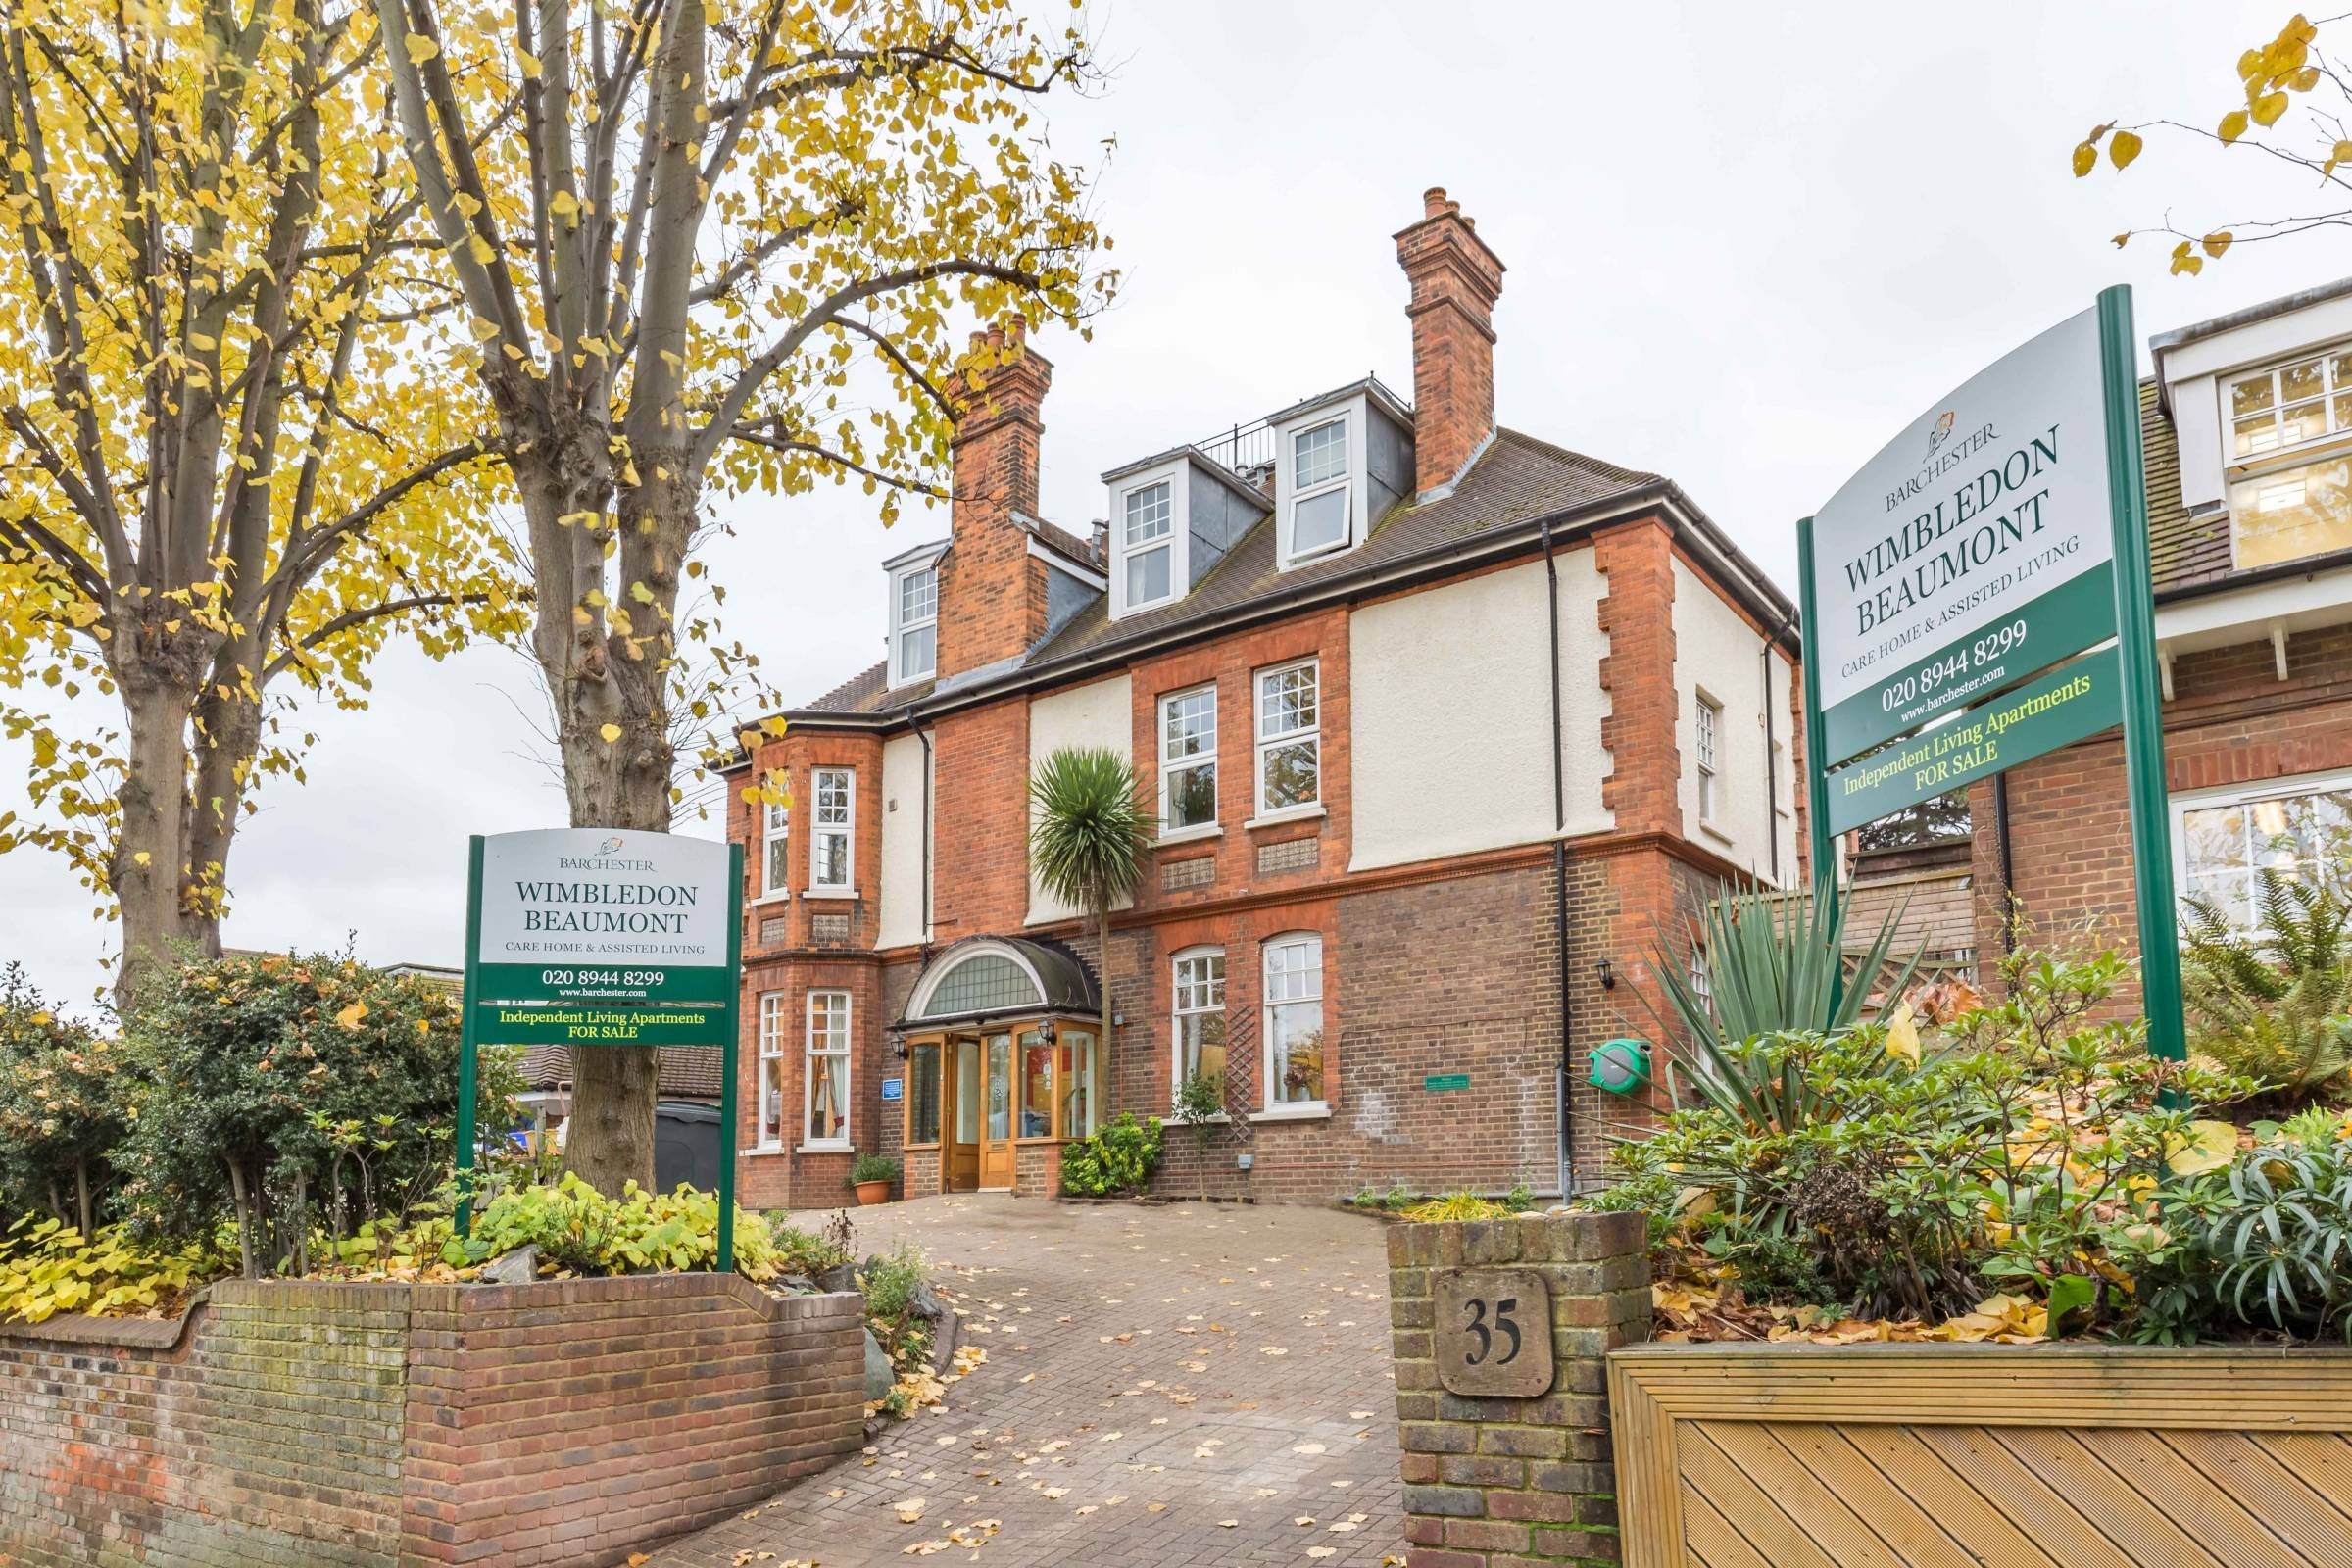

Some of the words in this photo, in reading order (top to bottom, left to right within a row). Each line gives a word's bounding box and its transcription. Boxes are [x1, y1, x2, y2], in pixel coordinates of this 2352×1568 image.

[1885, 423, 2001, 513] BARCHESTER
[1844, 424, 2060, 592] WIMBLEDON
[1856, 488, 2048, 636] BEAUMONT
[1841, 649, 1876, 679] CARE
[1879, 624, 1922, 658] HOME
[1924, 619, 1935, 632] &
[1937, 574, 2012, 622] ASSISTED
[2017, 535, 2080, 580] LIVING
[1882, 676, 1916, 713] 020
[1920, 655, 1969, 694] 8944
[1974, 619, 2028, 663] 8299
[1900, 665, 2005, 724] www.barchester.com
[1843, 744, 1931, 796] Independent
[1933, 723, 1982, 757] Living
[1984, 674, 2091, 736] Apartments
[1914, 766, 1949, 792] FOR
[1952, 740, 1998, 776] SALE
[560, 857, 657, 873] BARCHESTER
[515, 881, 699, 906] WIMBLEDON
[524, 909, 688, 934] BEAUMONT
[505, 941, 540, 952] CARE
[544, 942, 582, 953] HOME
[587, 943, 594, 953] &
[598, 943, 658, 955] ASSISTED
[662, 946, 705, 956] LIVING
[542, 970, 574, 985] 020
[578, 971, 619, 986] 8944
[623, 971, 664, 986] 8299
[559, 988, 647, 998] www.barchester.com
[500, 1011, 583, 1024] Independent
[588, 1011, 626, 1026] Living
[629, 1012, 705, 1026] Apartments
[568, 1026, 598, 1038] FOR
[601, 1027, 638, 1039] SALE
[1464, 1298, 1521, 1365] 35
